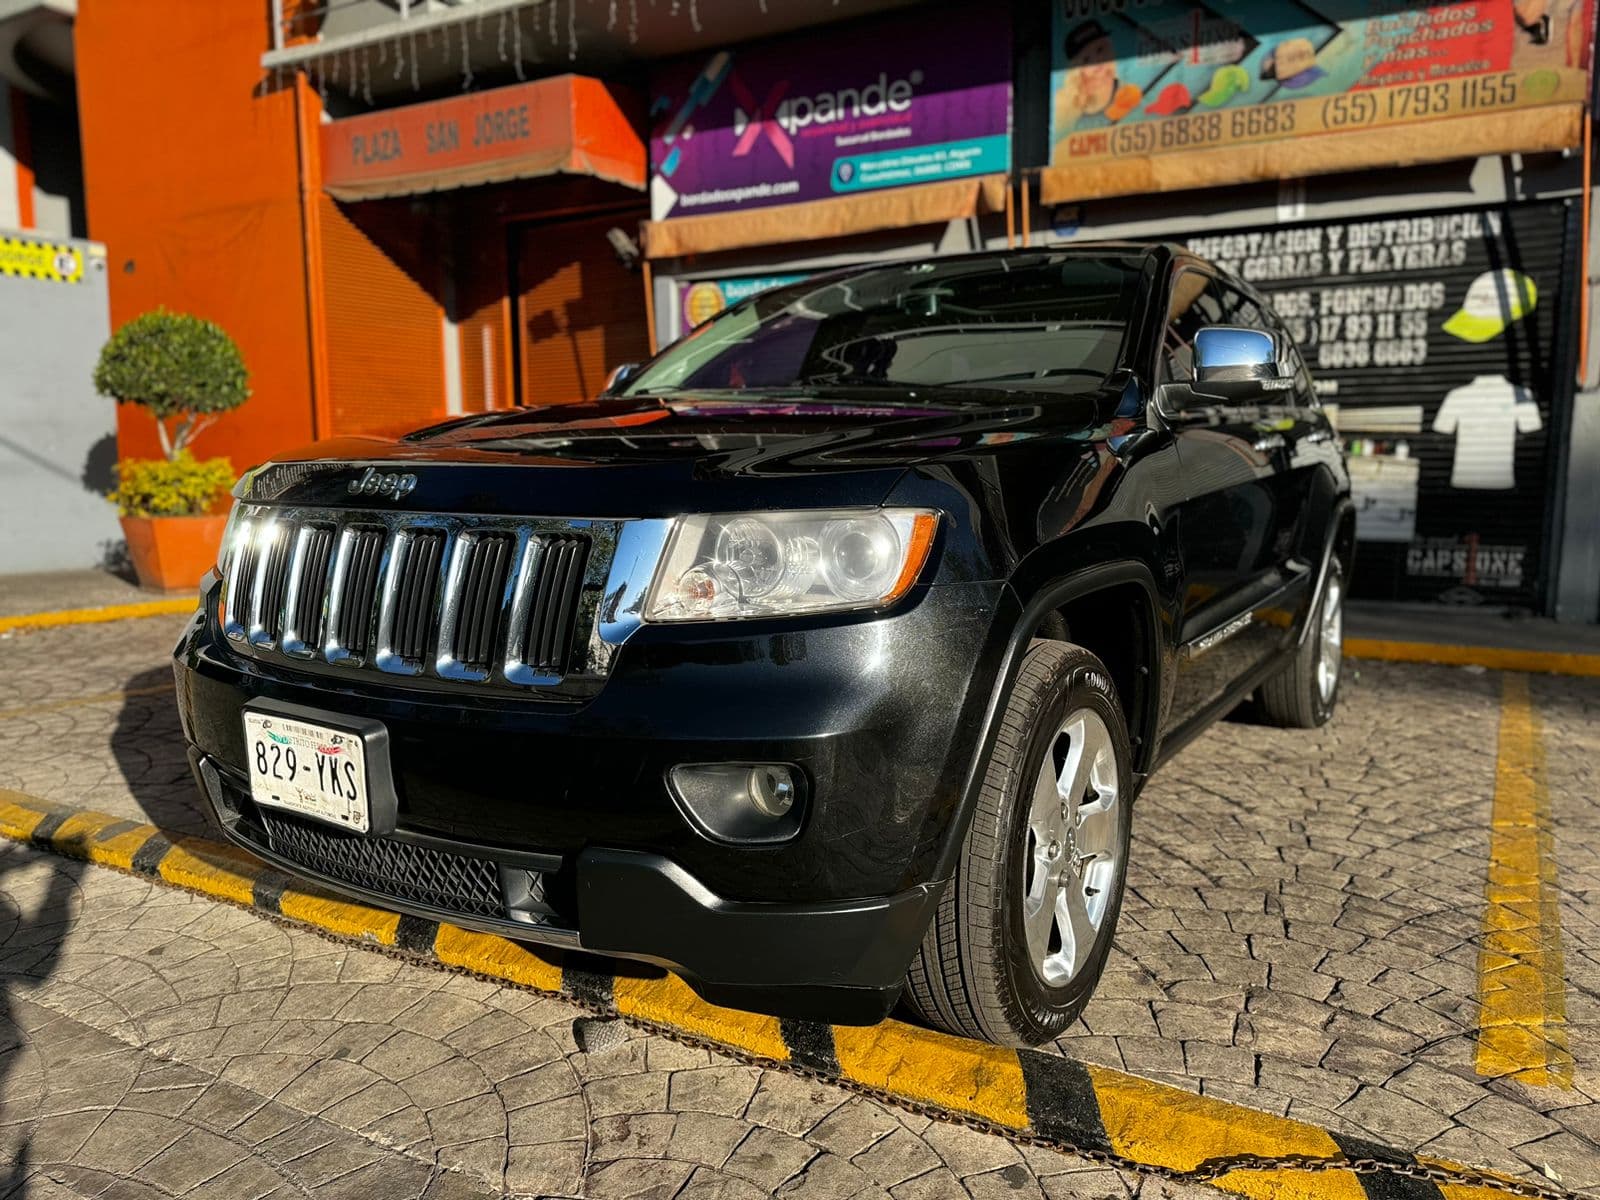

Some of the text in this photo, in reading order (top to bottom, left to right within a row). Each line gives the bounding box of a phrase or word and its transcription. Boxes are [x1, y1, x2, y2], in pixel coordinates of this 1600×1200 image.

[1364, 19, 1494, 49] Ponchados
[1110, 124, 1156, 159] (55)
[1160, 112, 1222, 148] 6838
[1231, 102, 1297, 138] 6683
[1321, 89, 1377, 127] (55)
[1387, 82, 1451, 118] 1793
[1458, 72, 1517, 110] 1155
[352, 105, 531, 166] PLAZA SAN JORGE
[1326, 225, 1344, 250] Y
[1244, 251, 1323, 282] GORRAS
[1328, 250, 1345, 275] Y
[1352, 240, 1467, 273] PLAYERAS
[1319, 282, 1446, 316] PONCHADOS
[347, 466, 418, 501] Jeep
[256, 740, 358, 801] 829-YKS
